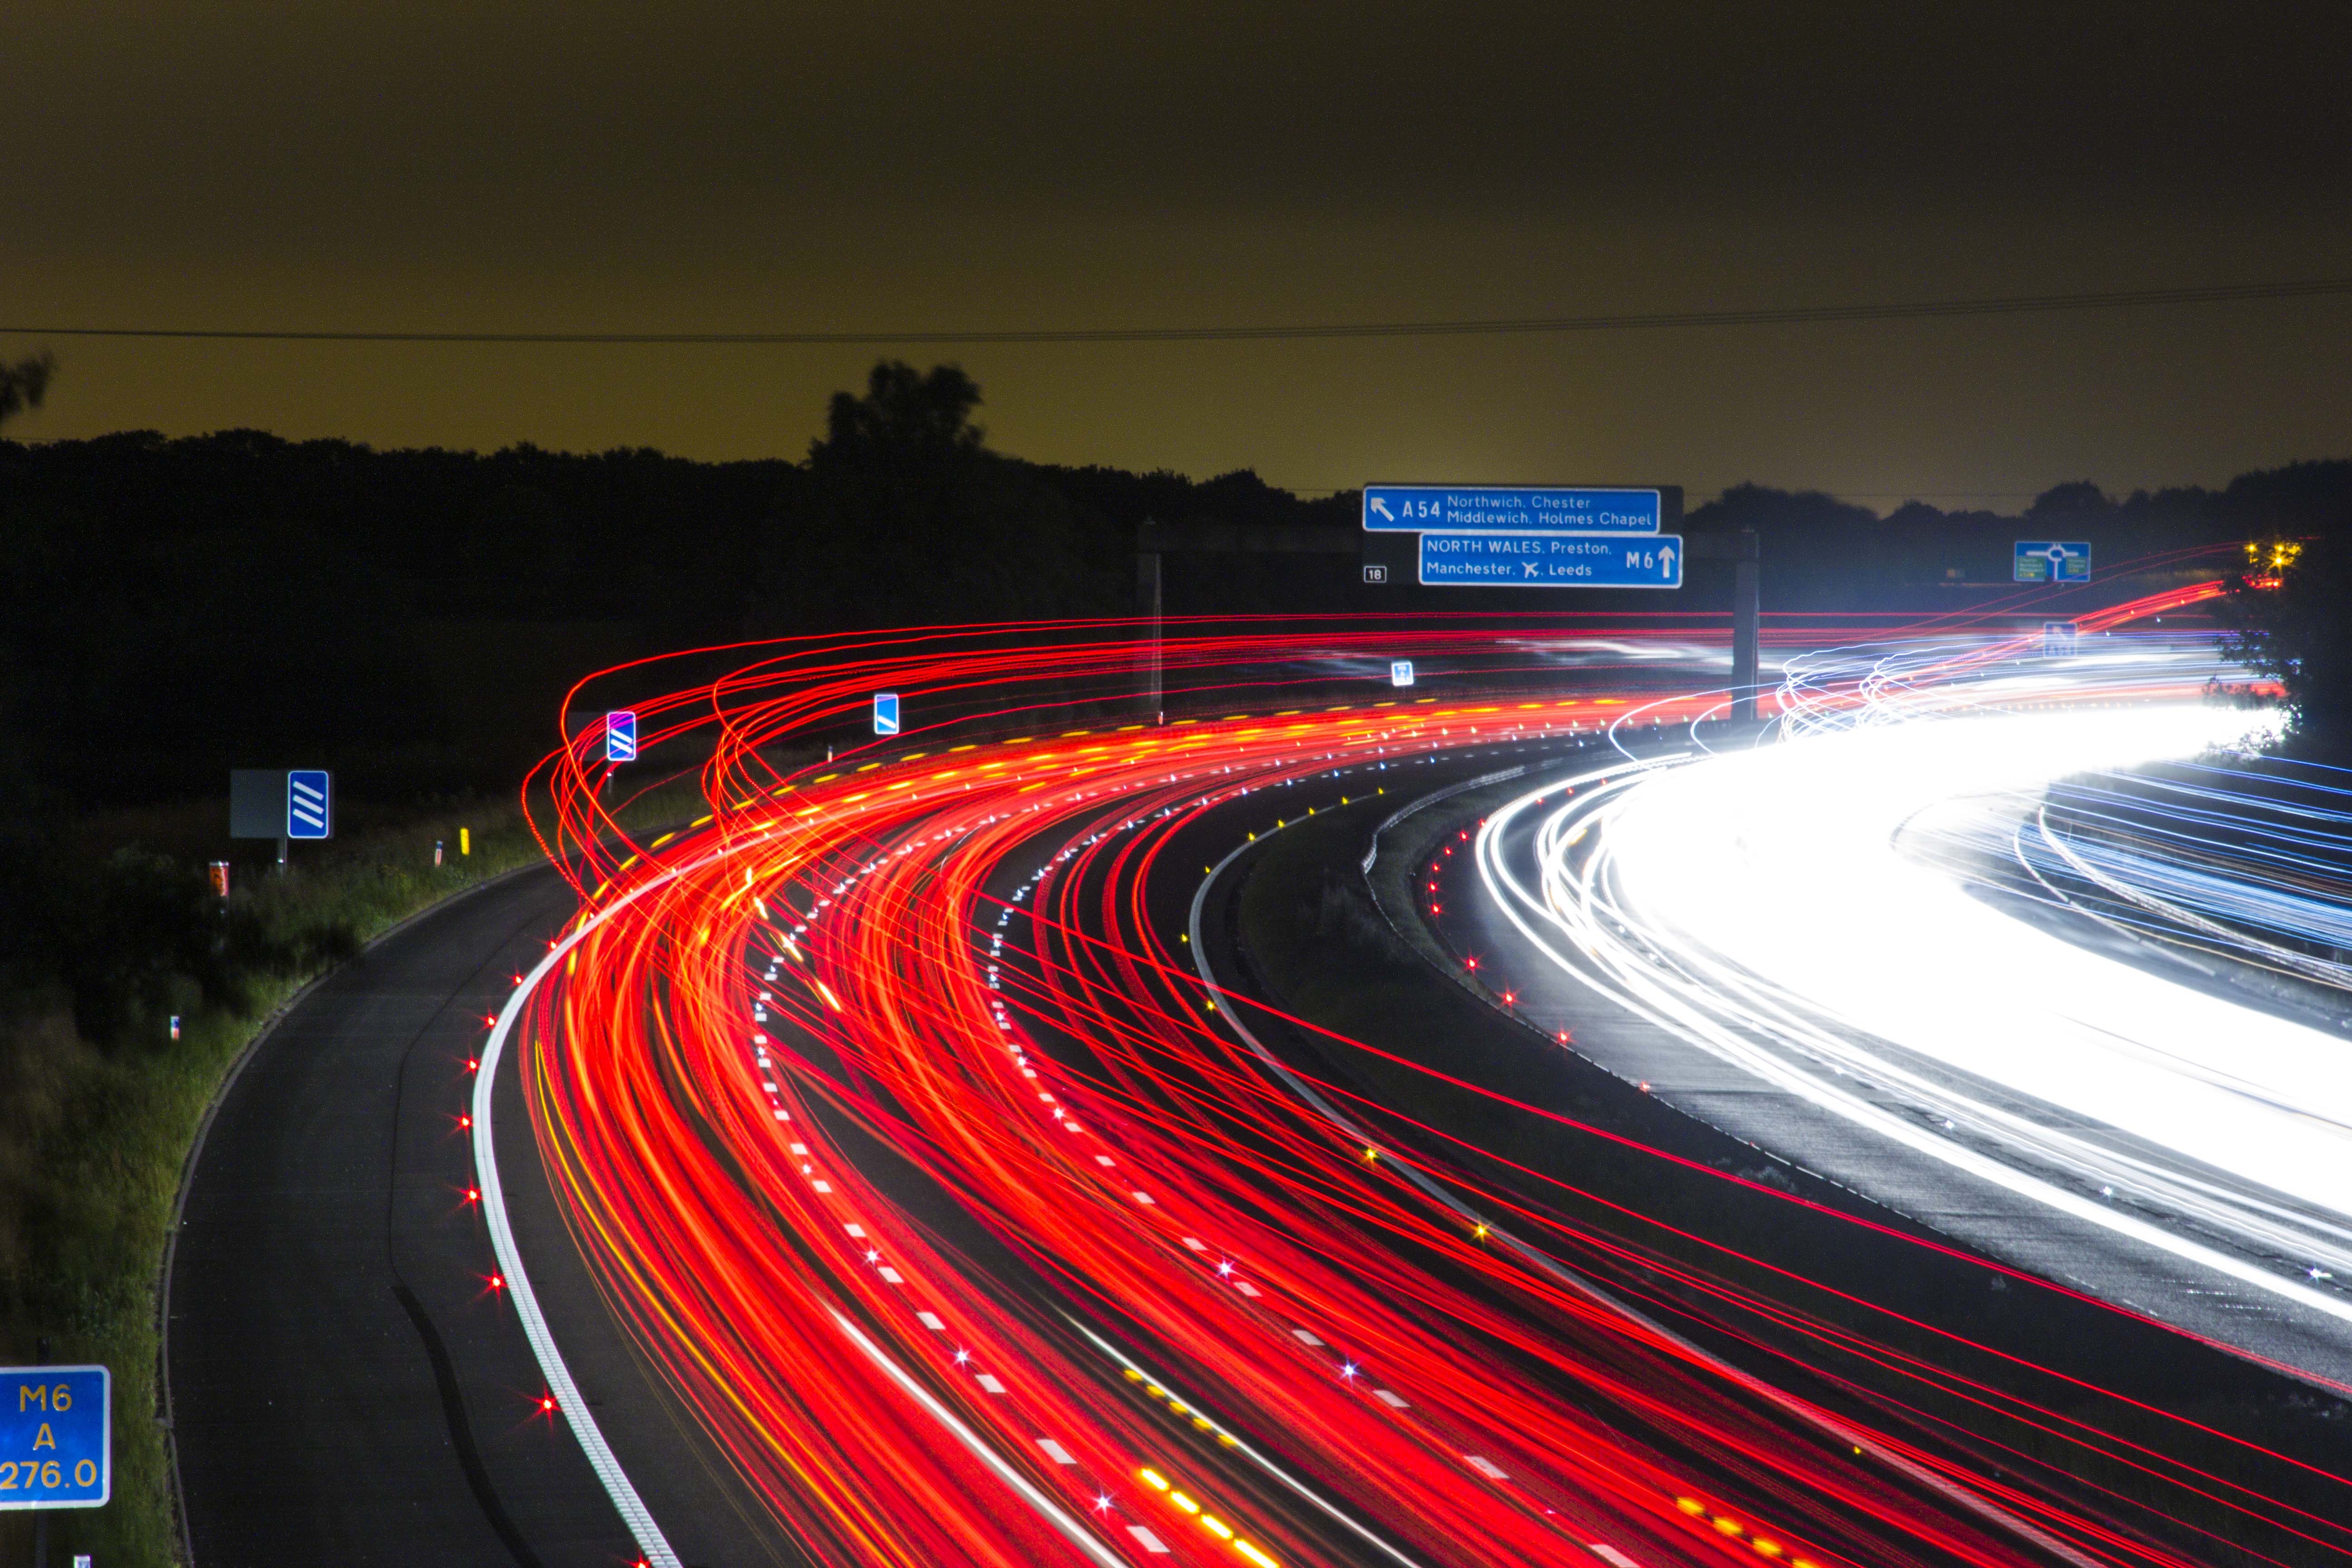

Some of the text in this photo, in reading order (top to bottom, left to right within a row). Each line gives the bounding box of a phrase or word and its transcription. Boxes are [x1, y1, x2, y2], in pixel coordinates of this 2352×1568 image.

[1531, 495, 1591, 509] Chester
[1447, 510, 1651, 527] Middlewich, Holmes Chapel
[1427, 540, 1482, 552] NORTH
[1368, 569, 1382, 580] 18
[1549, 564, 1592, 576] Leeds
[20, 1383, 73, 1412] M6
[33, 1423, 56, 1450] A
[0, 1459, 97, 1490] 276.0
